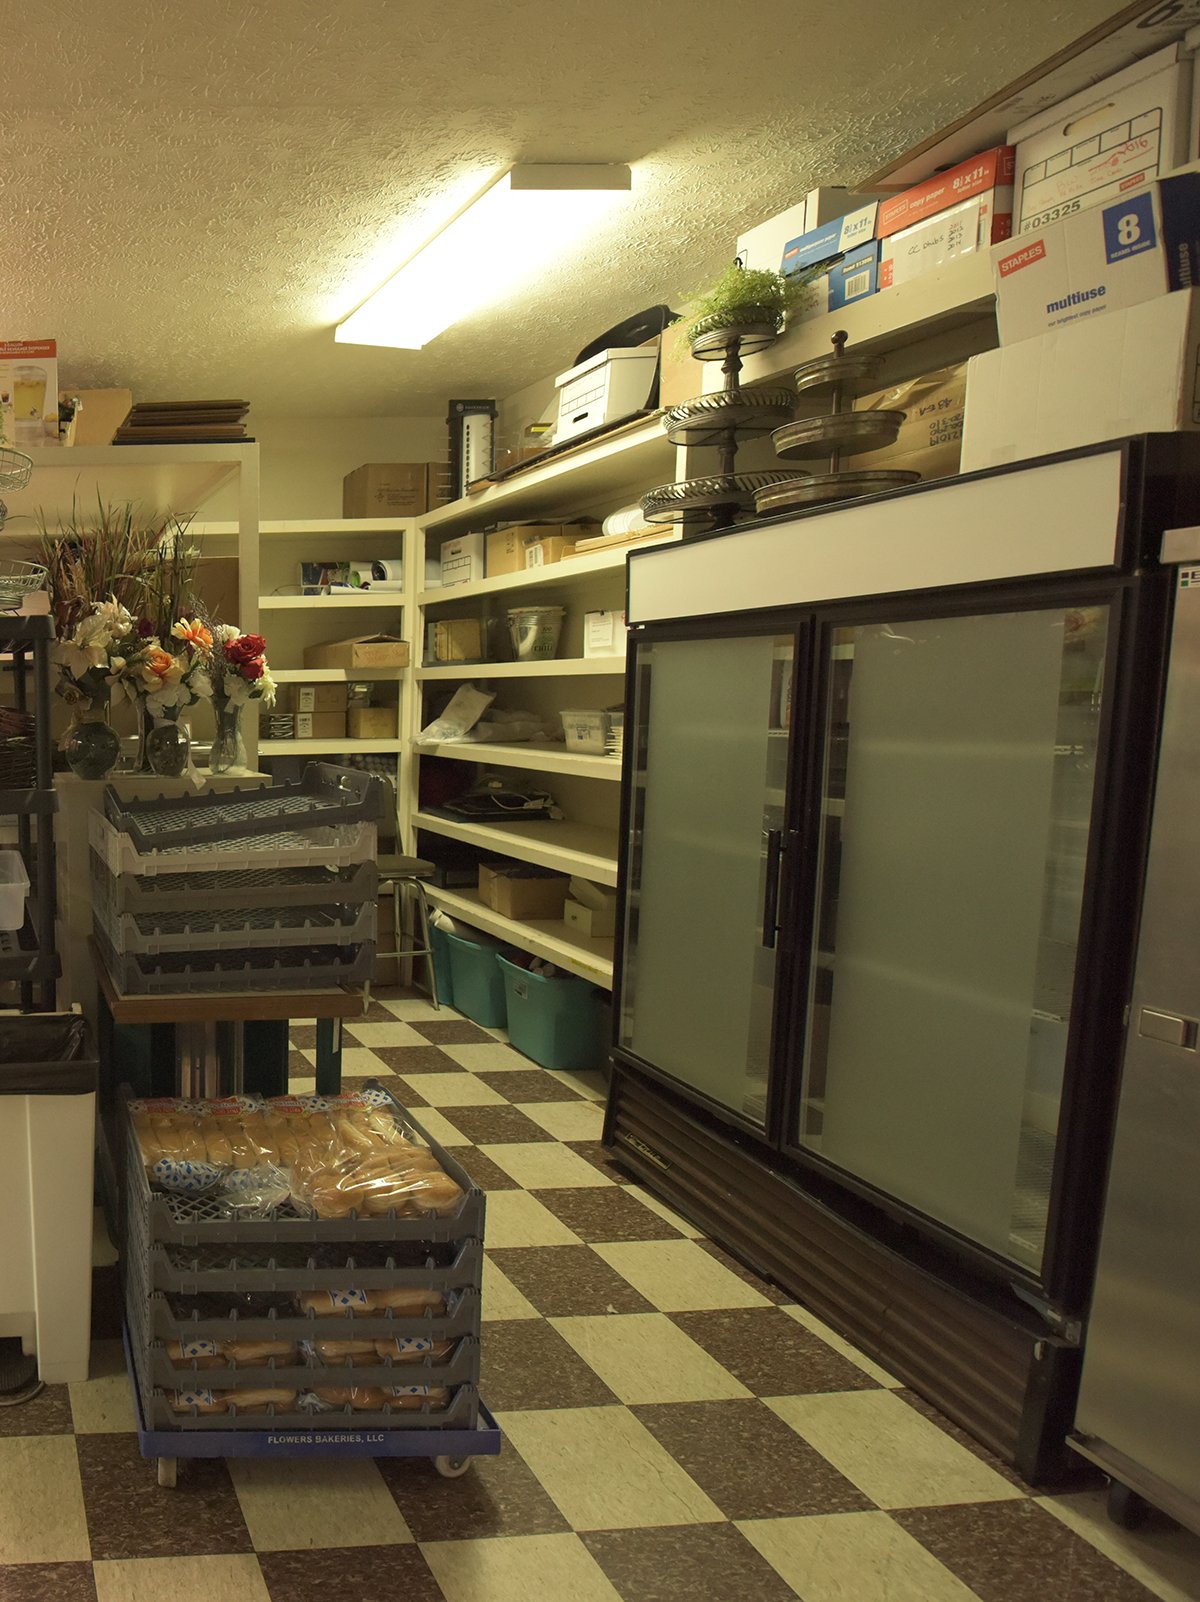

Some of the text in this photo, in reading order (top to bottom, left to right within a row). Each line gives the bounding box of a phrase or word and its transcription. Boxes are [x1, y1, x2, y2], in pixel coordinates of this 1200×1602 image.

[1024, 200, 1081, 232] #03325
[1117, 213, 1141, 246] 8
[1001, 245, 1043, 272] STAPLES
[1179, 242, 1191, 288] ultiuse
[1046, 285, 1106, 314] multiuse
[267, 1434, 385, 1444] FLOWERS BAKERIES, LLC
